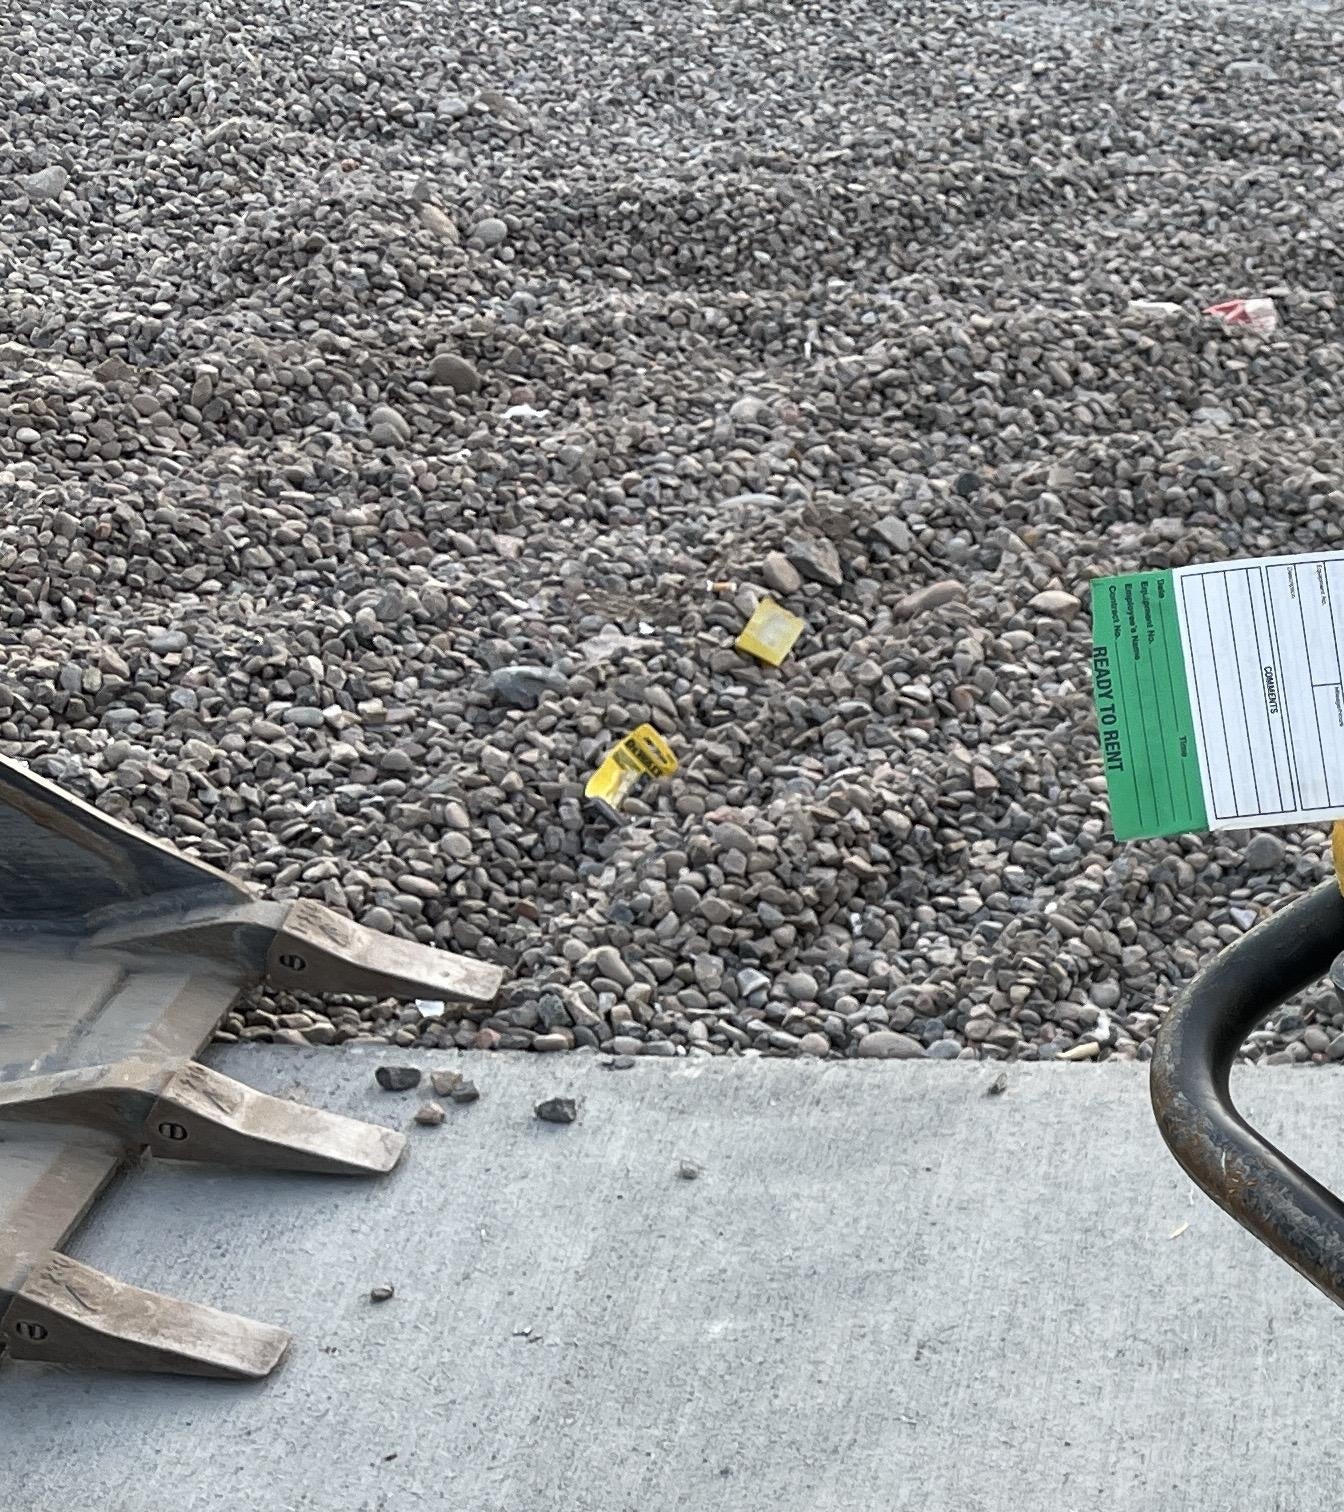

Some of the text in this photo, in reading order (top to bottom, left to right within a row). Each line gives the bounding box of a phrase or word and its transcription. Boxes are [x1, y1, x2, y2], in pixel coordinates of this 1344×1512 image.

[1108, 586, 1123, 639] Contract No.
[1123, 583, 1142, 660] Employee's Name
[1139, 581, 1156, 645] Equipment No.
[1157, 580, 1189, 757] Date Time
[1264, 666, 1279, 714] COMMENTS
[1092, 646, 1124, 773] READY TO RENT
